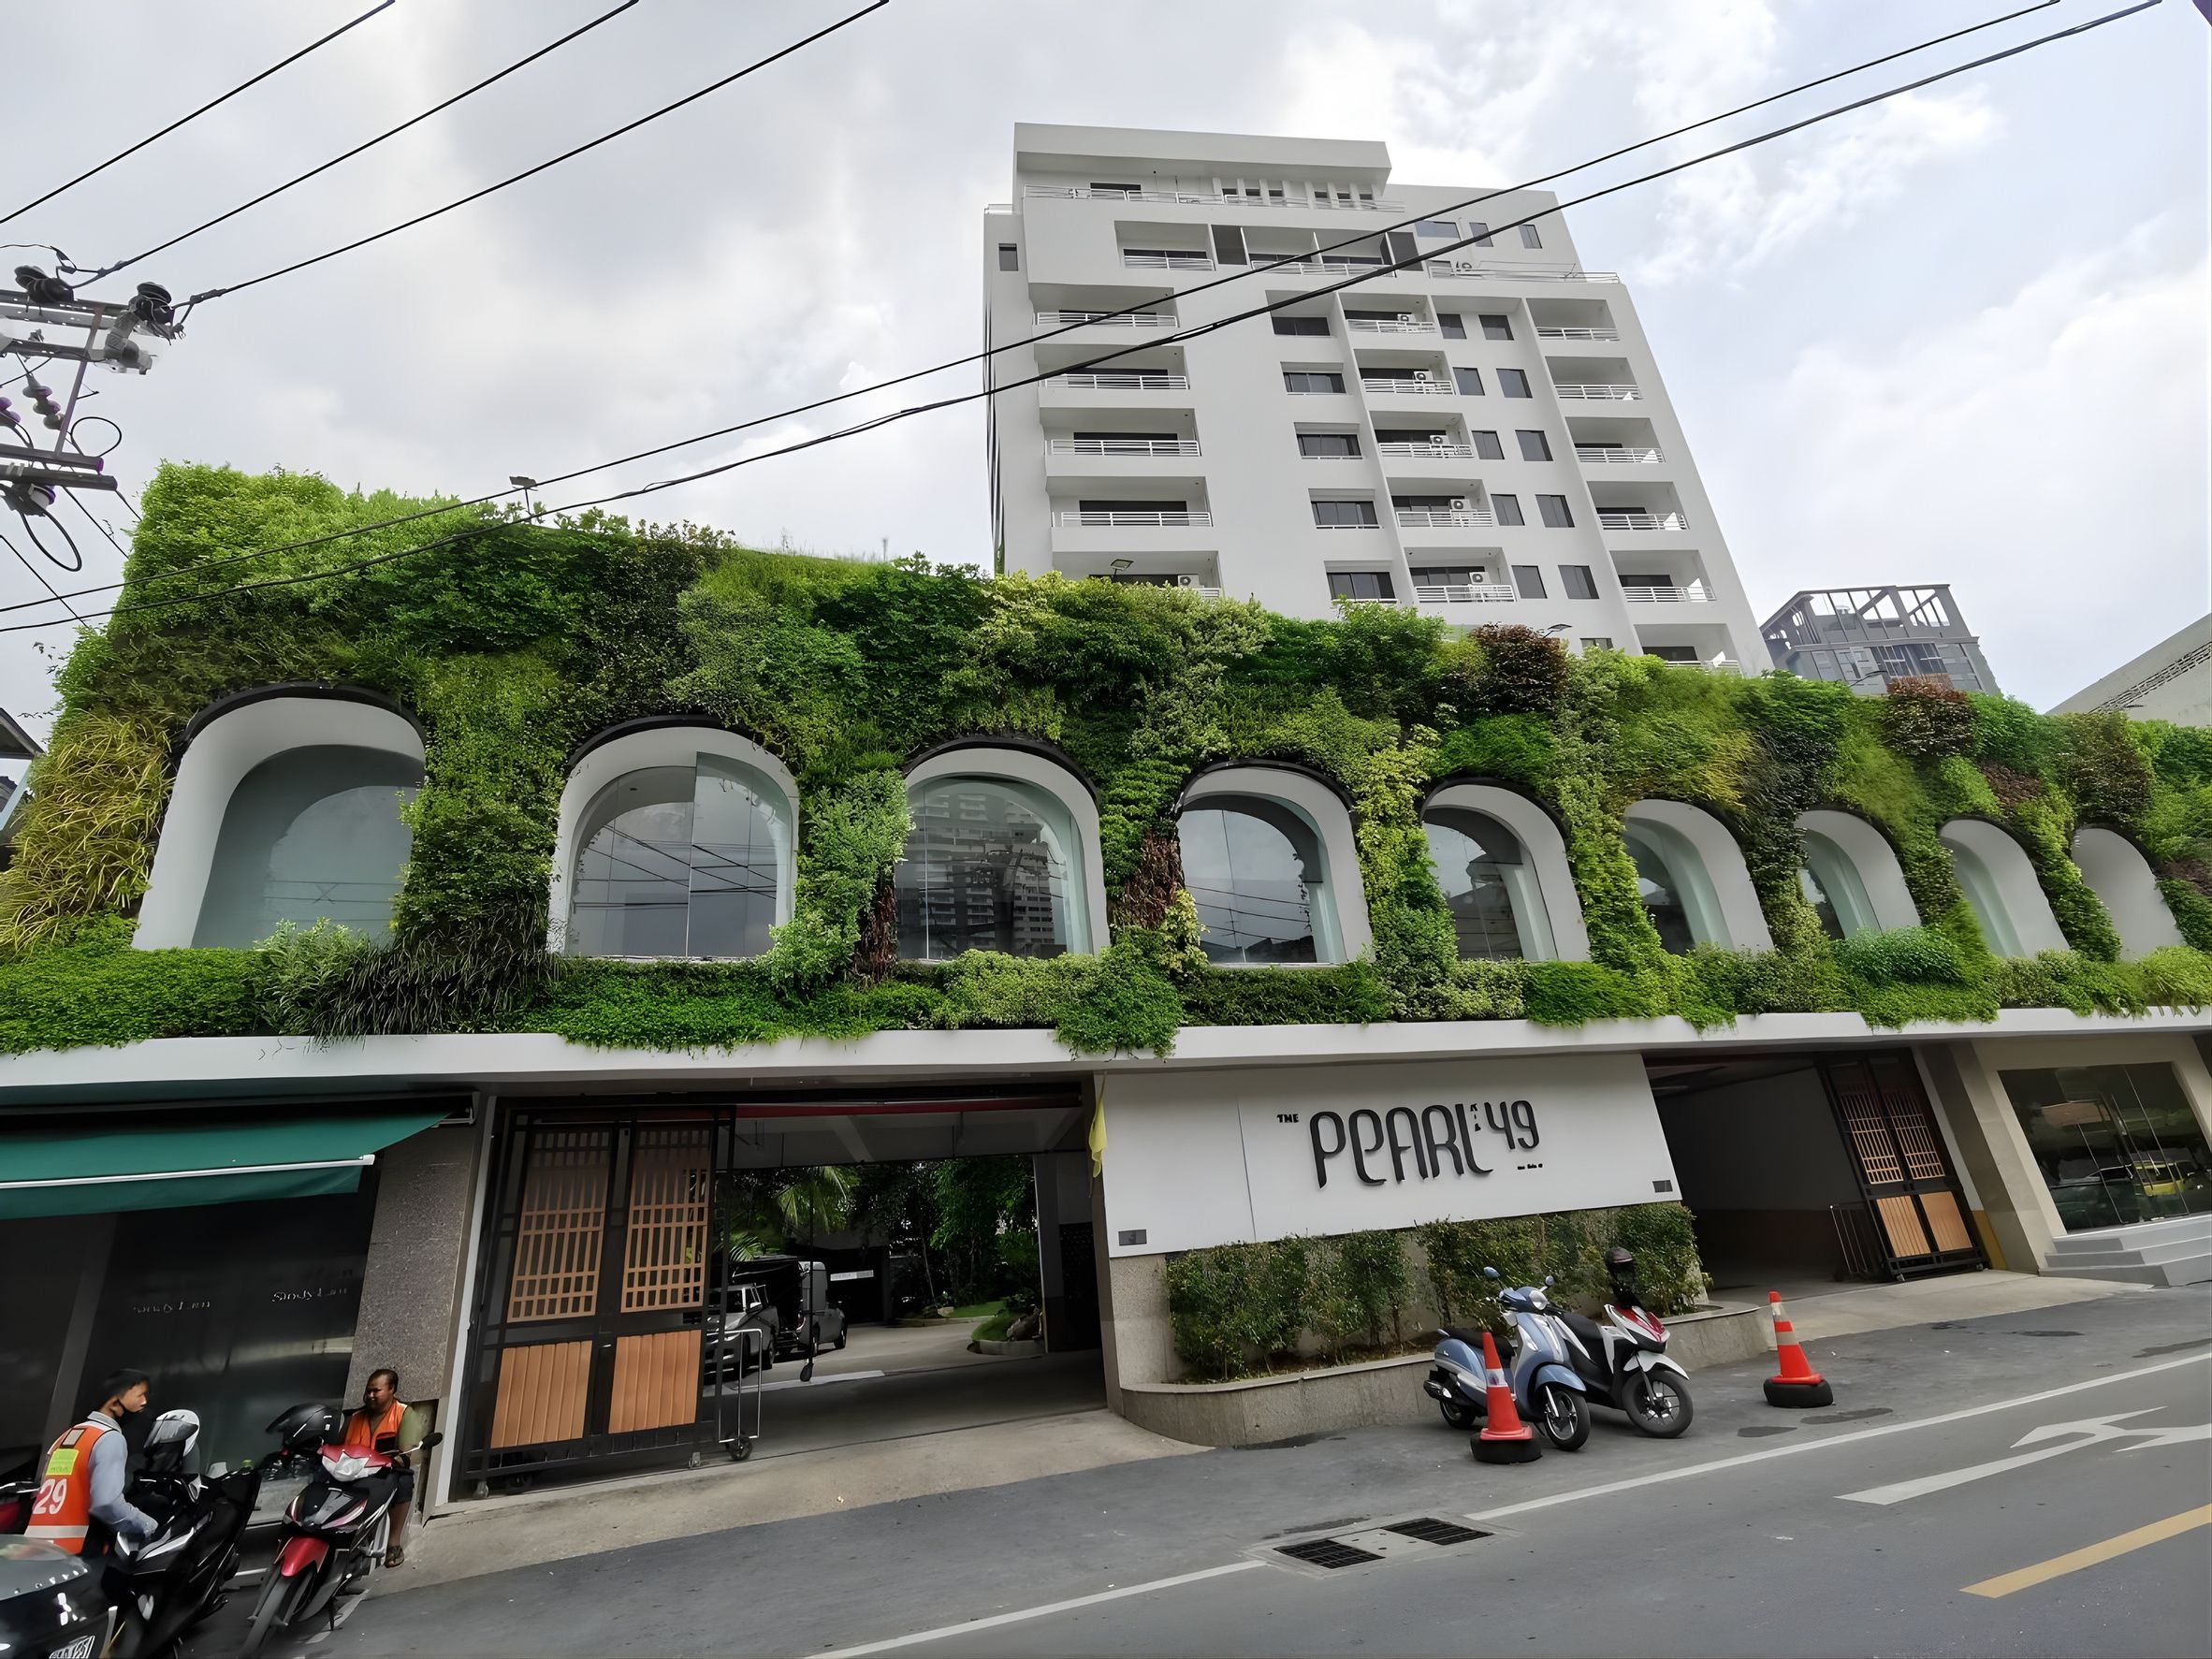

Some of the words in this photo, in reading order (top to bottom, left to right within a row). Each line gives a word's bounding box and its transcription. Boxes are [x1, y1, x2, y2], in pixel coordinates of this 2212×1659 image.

[1276, 1113, 1300, 1124] THE
[1309, 1102, 1494, 1189] PEARL
[1483, 1099, 1540, 1150] 49
[32, 1477, 67, 1515] 29
